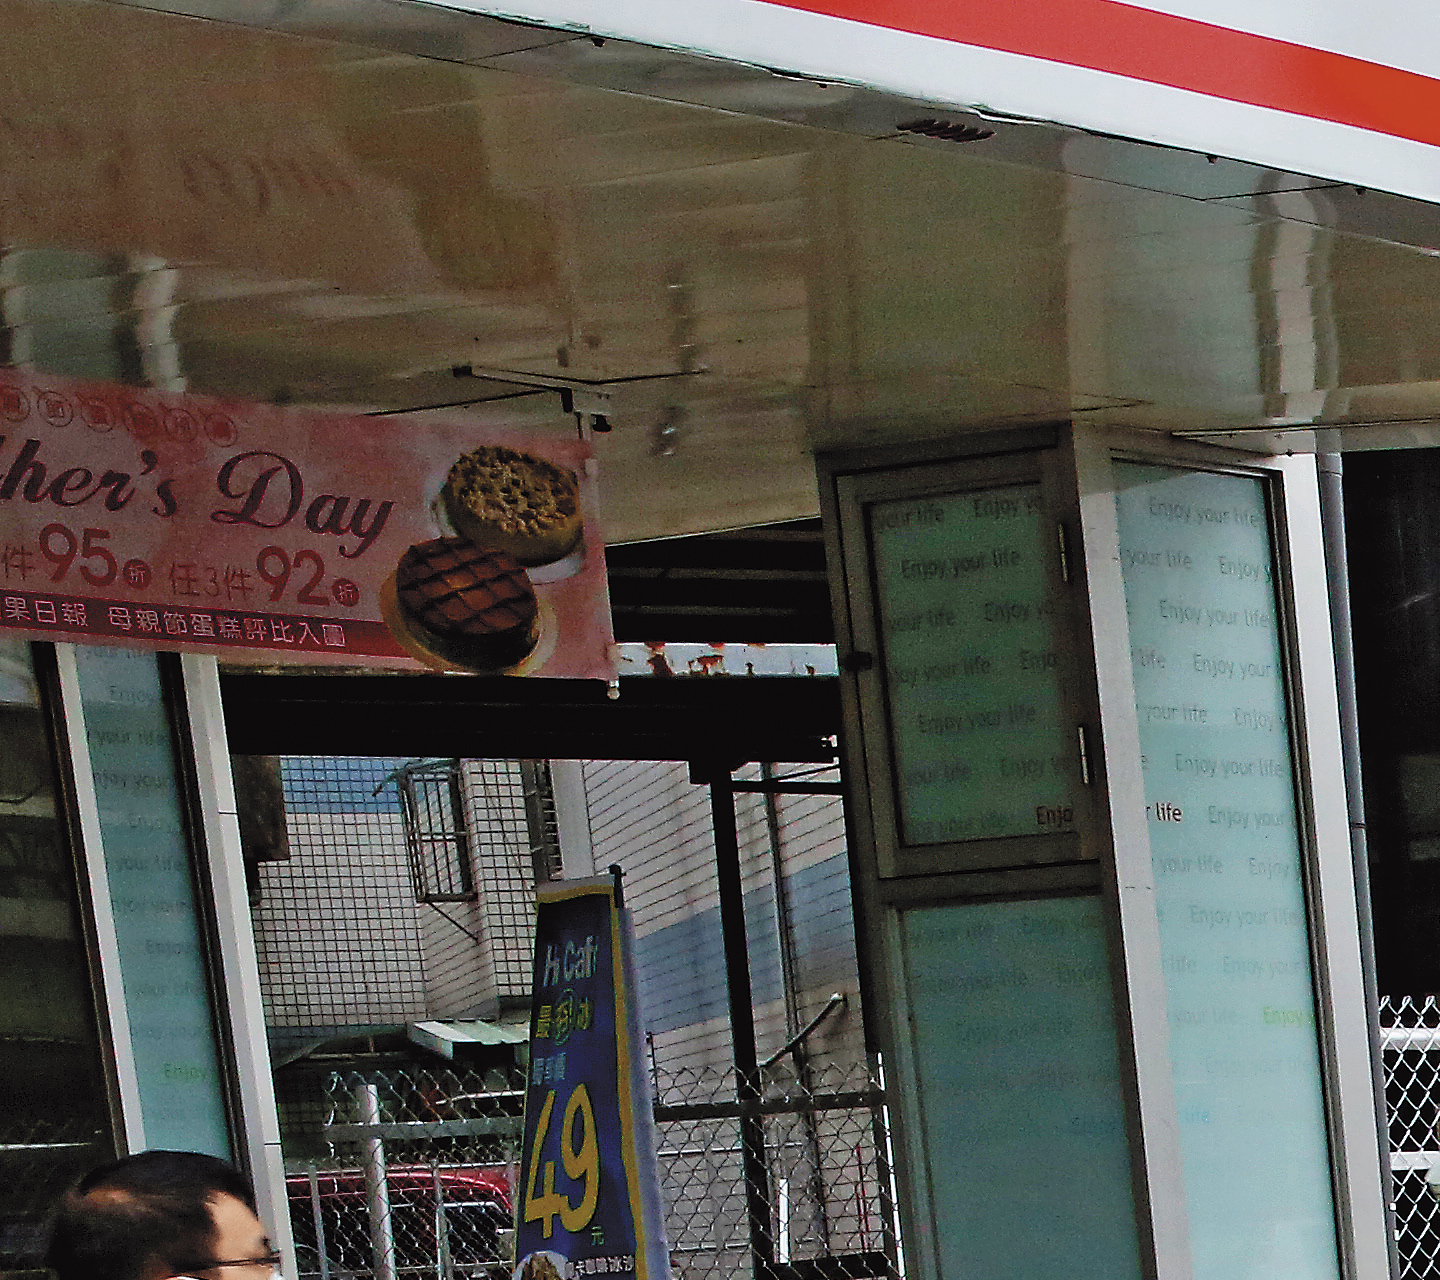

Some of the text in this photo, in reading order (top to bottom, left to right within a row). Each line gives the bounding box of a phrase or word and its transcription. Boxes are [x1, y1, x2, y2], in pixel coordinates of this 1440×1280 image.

[210, 450, 396, 559] Day
[1156, 802, 1183, 823] life
[524, 1083, 599, 1239] 49
